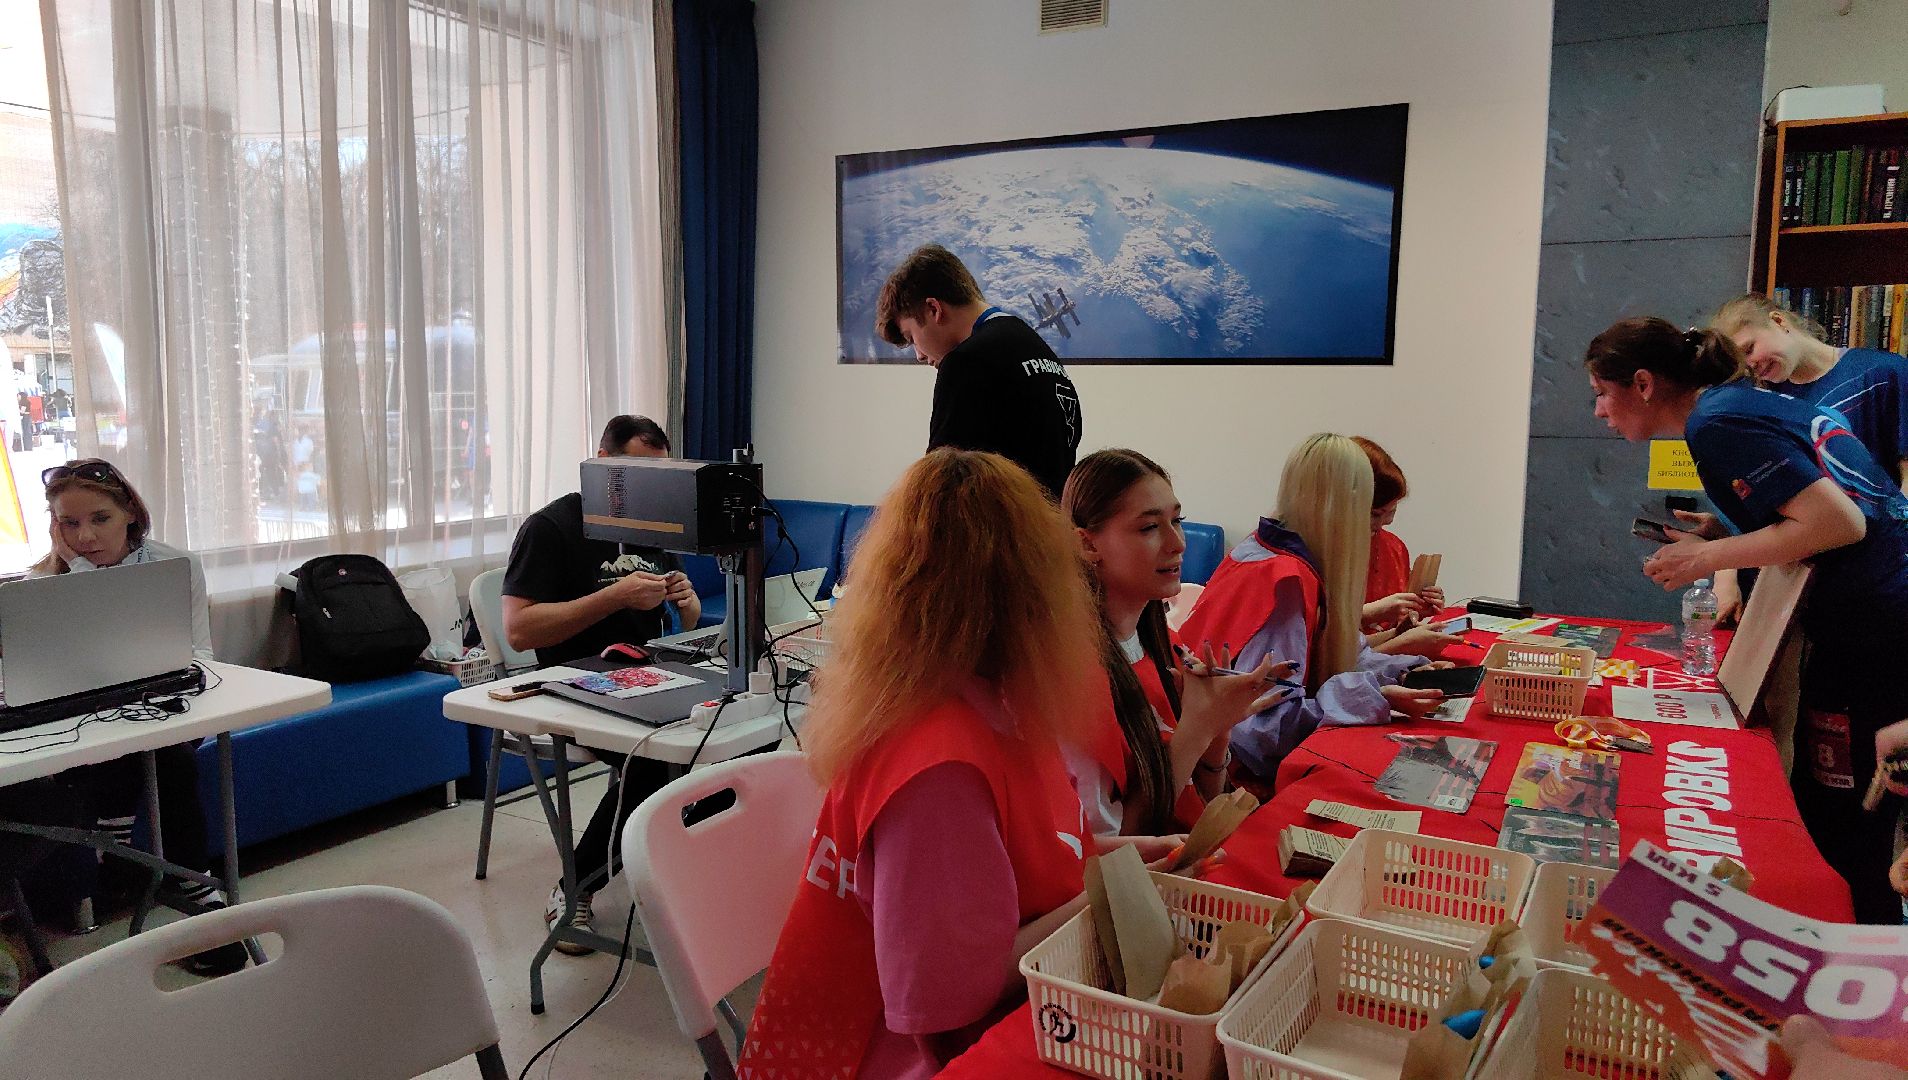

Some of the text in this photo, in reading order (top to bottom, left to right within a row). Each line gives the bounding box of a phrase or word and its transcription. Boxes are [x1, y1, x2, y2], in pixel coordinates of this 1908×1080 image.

[1654, 702, 1688, 719] 600
[806, 828, 856, 899] ЕР
[1663, 899, 1908, 1022] 058
